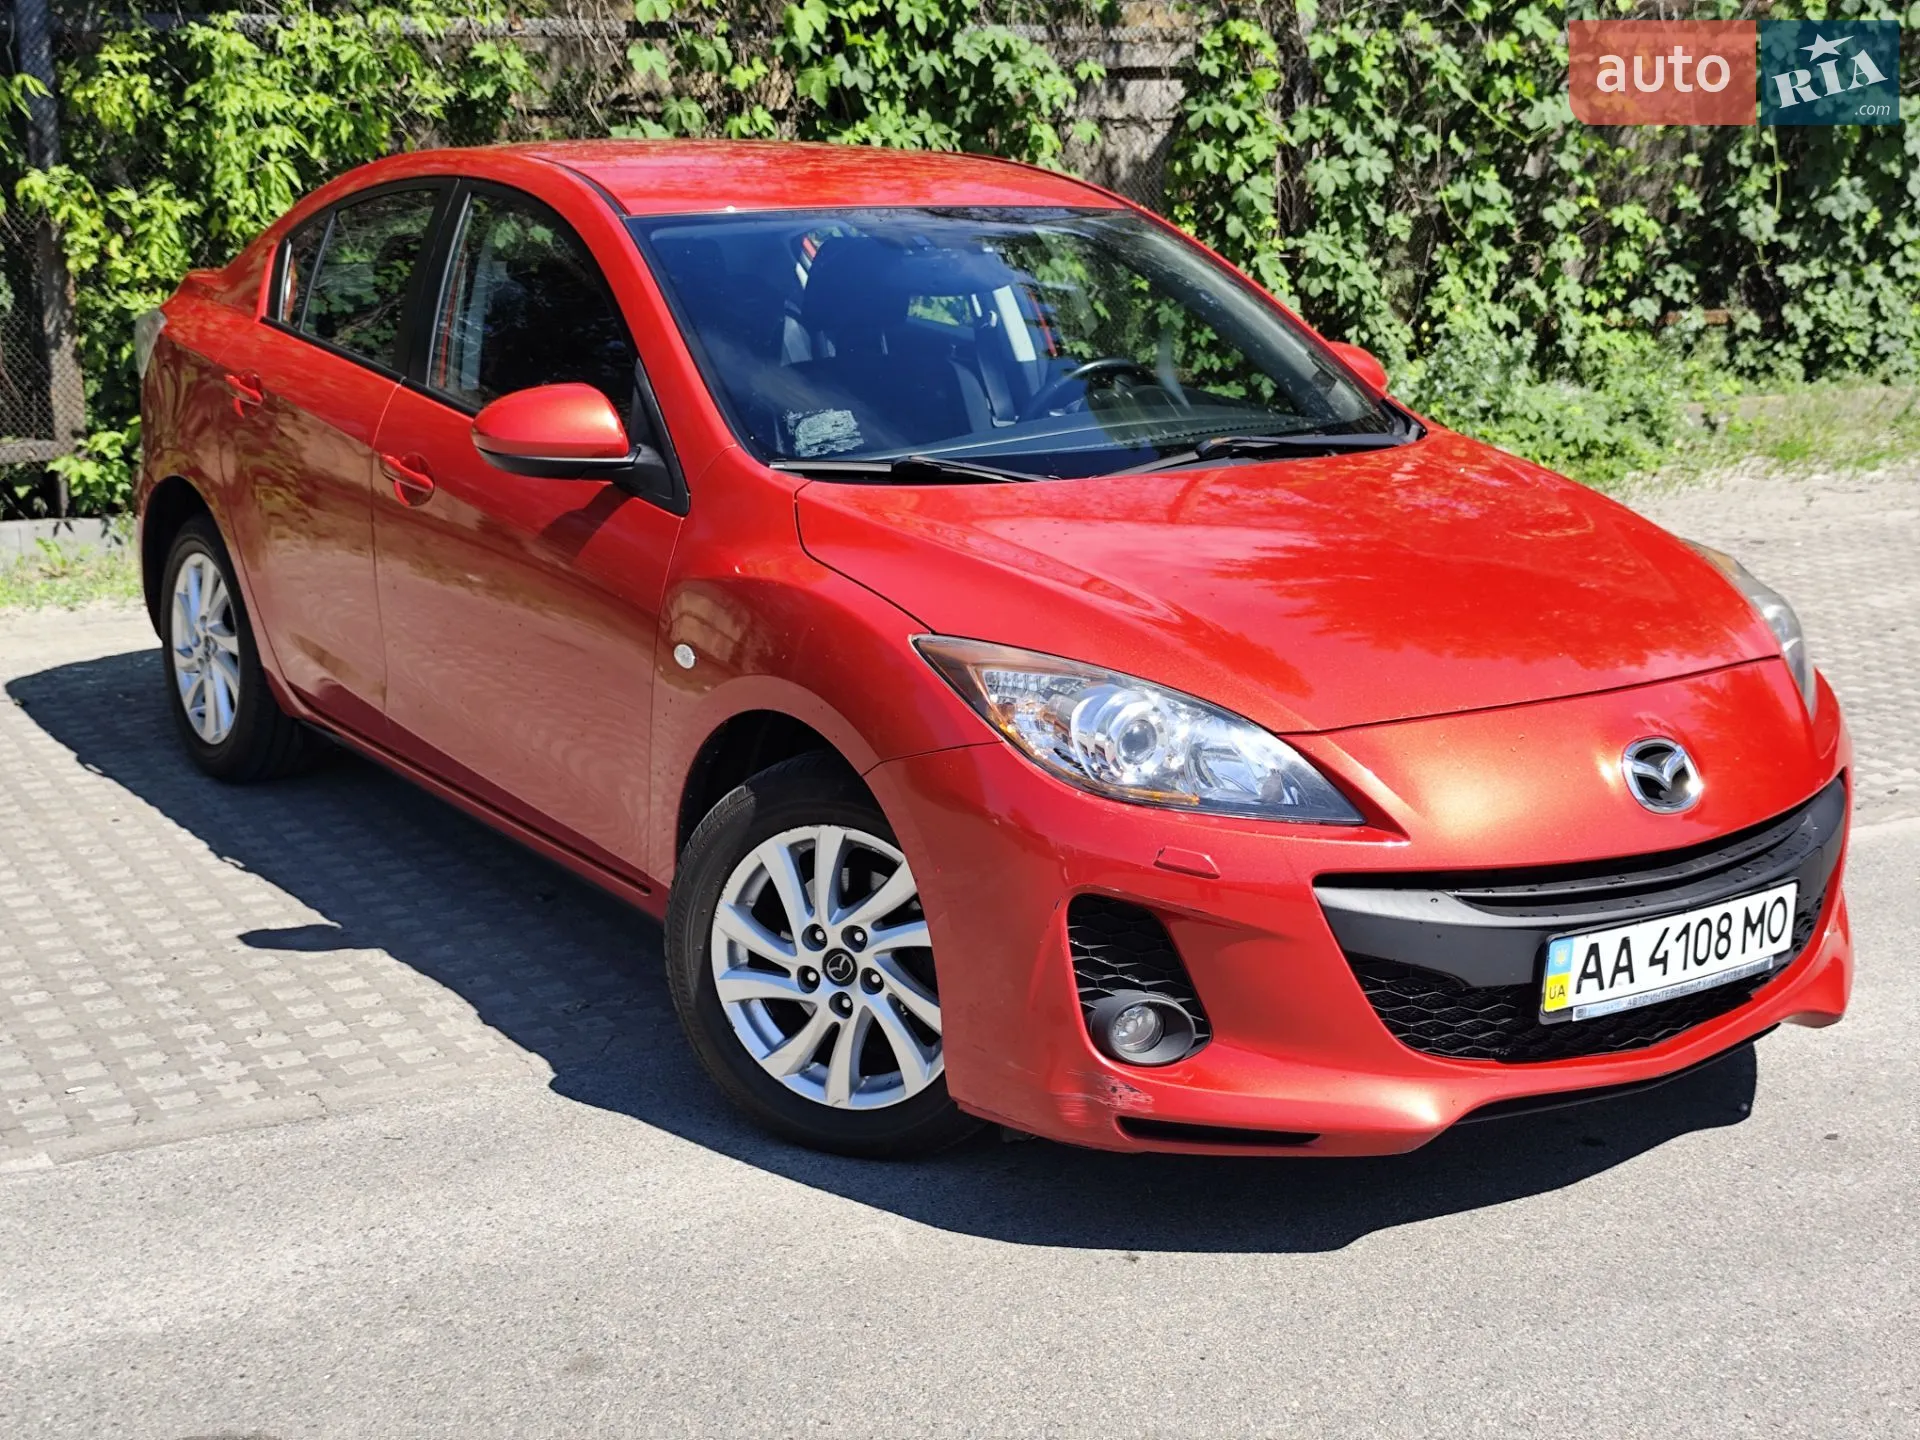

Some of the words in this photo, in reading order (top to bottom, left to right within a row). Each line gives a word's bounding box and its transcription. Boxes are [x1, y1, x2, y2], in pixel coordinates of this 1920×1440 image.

[1575, 936, 1635, 995] AA
[1649, 911, 1733, 976] 4108
[1741, 896, 1788, 955] MO
[1549, 984, 1566, 1000] UA
